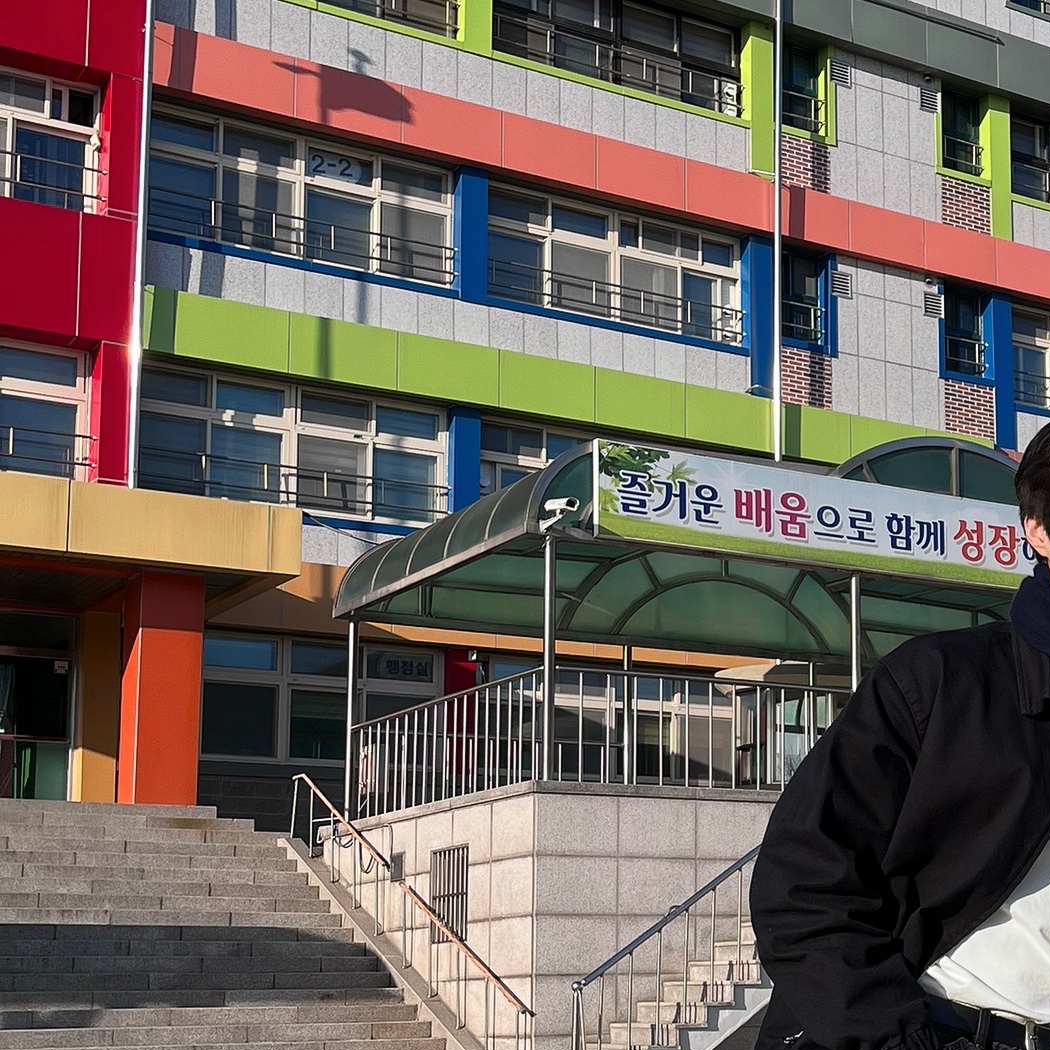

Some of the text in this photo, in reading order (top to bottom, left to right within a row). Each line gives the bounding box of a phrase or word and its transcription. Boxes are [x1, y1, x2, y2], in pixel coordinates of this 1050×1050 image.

[311, 154, 353, 177] 2-2
[616, 471, 724, 525] 즐거운
[732, 487, 877, 543] 배움으로
[884, 512, 946, 556] 함께
